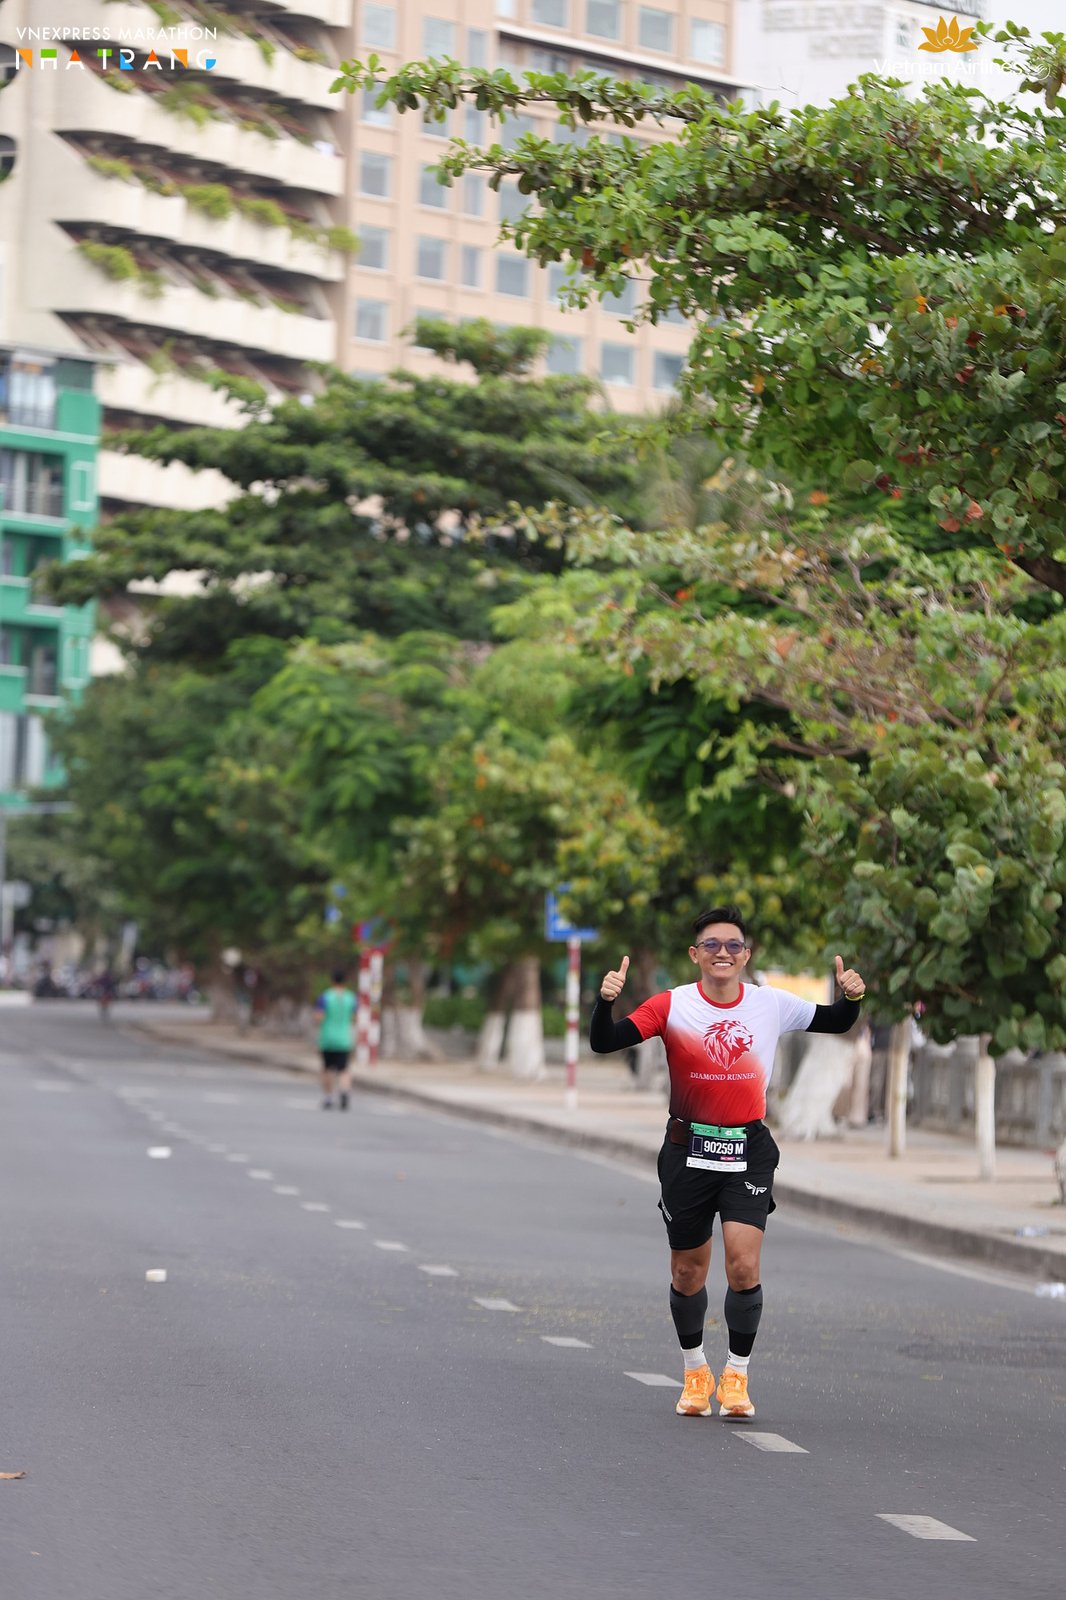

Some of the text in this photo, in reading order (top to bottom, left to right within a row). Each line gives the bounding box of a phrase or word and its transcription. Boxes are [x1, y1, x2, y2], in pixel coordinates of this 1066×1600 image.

[690, 1071, 726, 1081] DIAMOND
[703, 1140, 734, 1155] 90259
[735, 1142, 744, 1155] M
